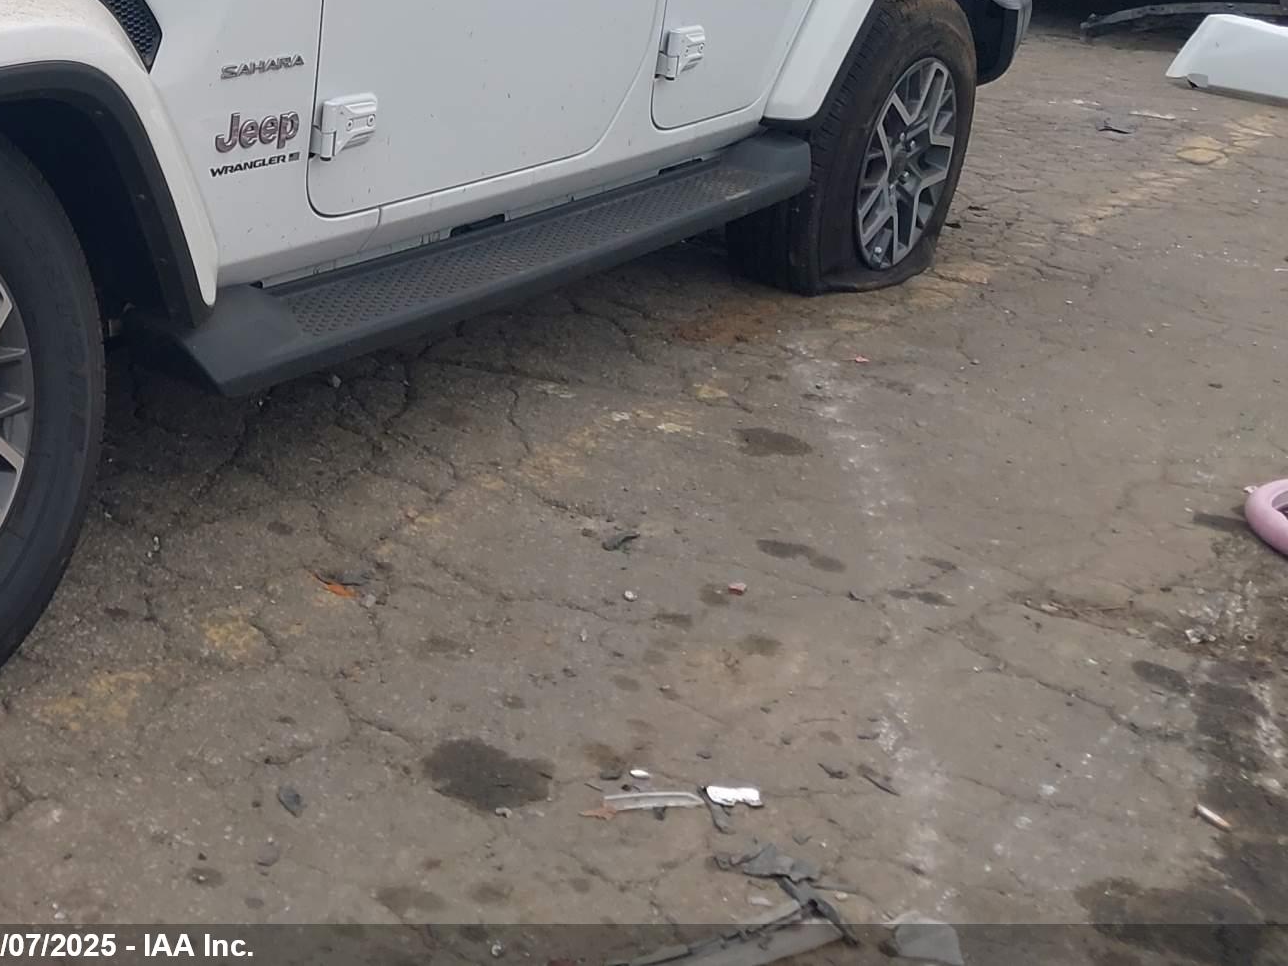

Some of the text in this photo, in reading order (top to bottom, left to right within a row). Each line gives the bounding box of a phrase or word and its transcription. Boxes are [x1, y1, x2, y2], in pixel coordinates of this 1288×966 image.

[220, 54, 305, 80] SAHARA
[215, 111, 300, 153] Jeep
[210, 154, 286, 178] WRANGLER
